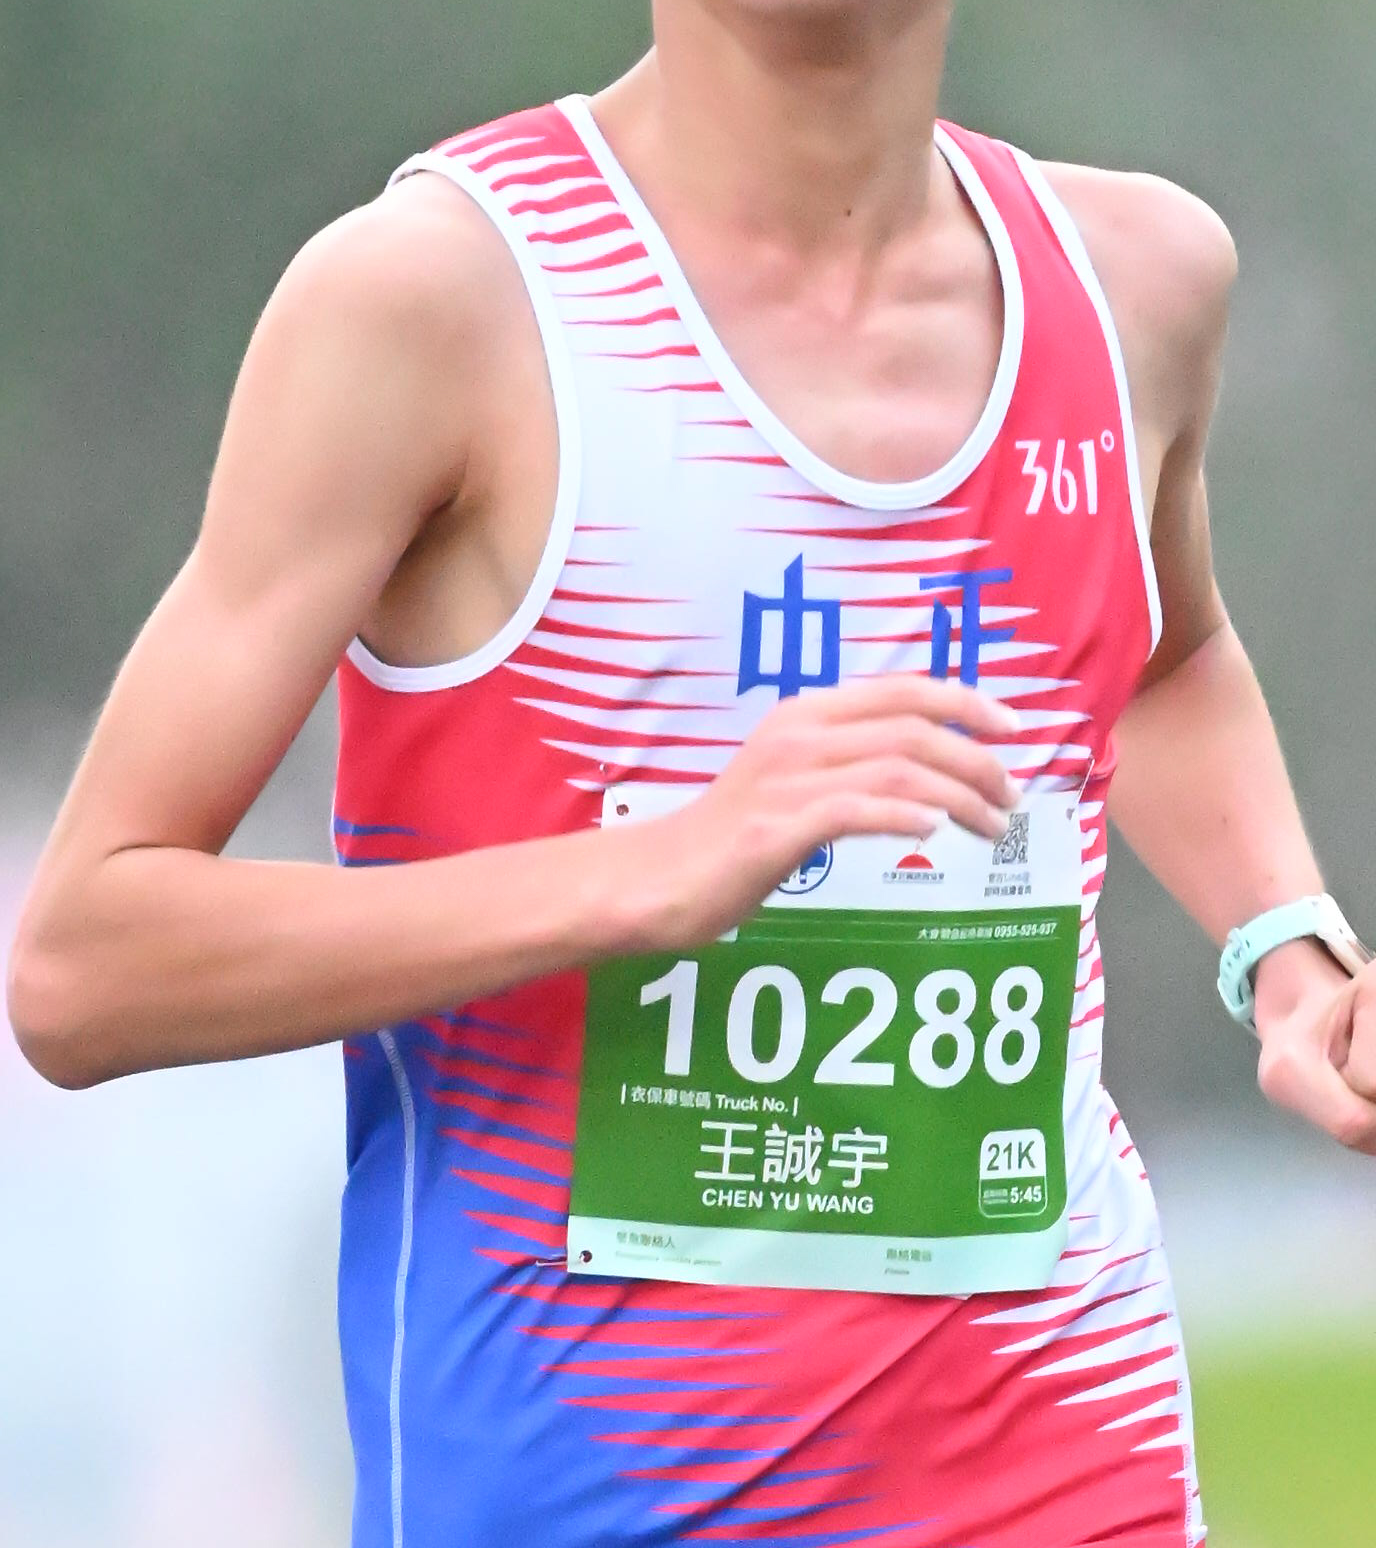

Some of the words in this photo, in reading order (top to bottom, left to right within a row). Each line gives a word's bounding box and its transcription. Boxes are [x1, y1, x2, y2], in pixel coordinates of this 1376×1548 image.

[639, 959, 1044, 1089] 10288
[715, 1093, 759, 1112] Truck
[761, 1096, 789, 1114] No.
[693, 1119, 890, 1189] 王誠宇
[986, 1140, 1036, 1171] 21K
[701, 1187, 764, 1209] CHEN
[769, 1190, 801, 1212] YU
[806, 1192, 874, 1215] WANG
[1010, 1184, 1043, 1204] 5:45
